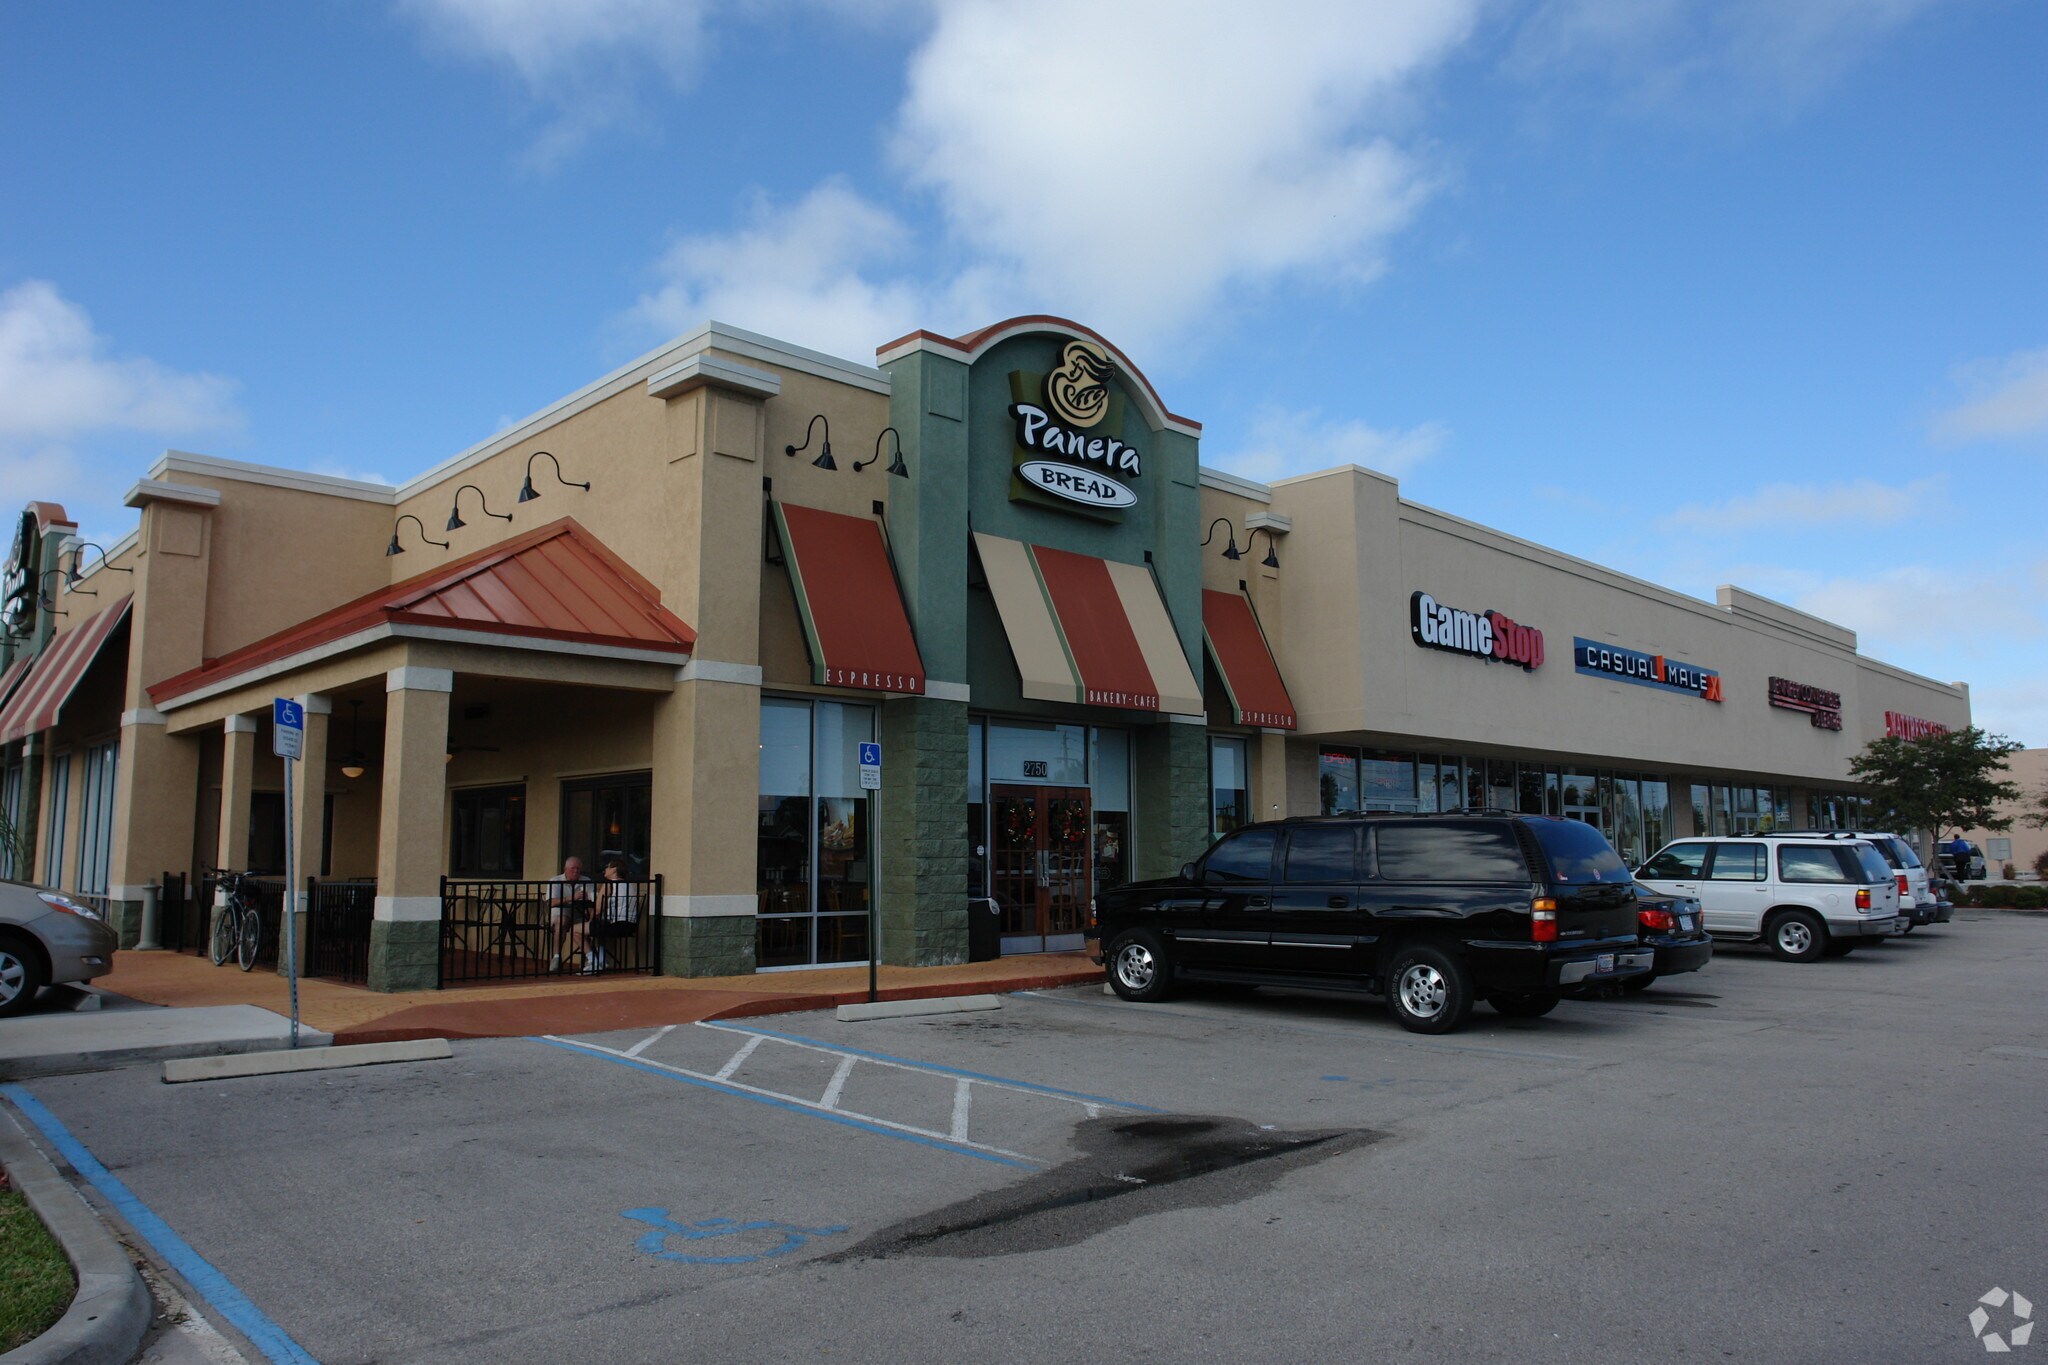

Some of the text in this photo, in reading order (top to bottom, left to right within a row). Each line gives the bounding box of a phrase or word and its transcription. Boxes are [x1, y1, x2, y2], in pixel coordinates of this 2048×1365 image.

[1016, 404, 1140, 475] Panera
[1040, 467, 1117, 499] BREAD
[1419, 594, 1544, 669] GameStop
[826, 668, 915, 690] ESPRESSO
[1587, 646, 1659, 680] CASUAL
[1240, 710, 1292, 726] ESPRESSO
[1024, 761, 1047, 776] 2750
